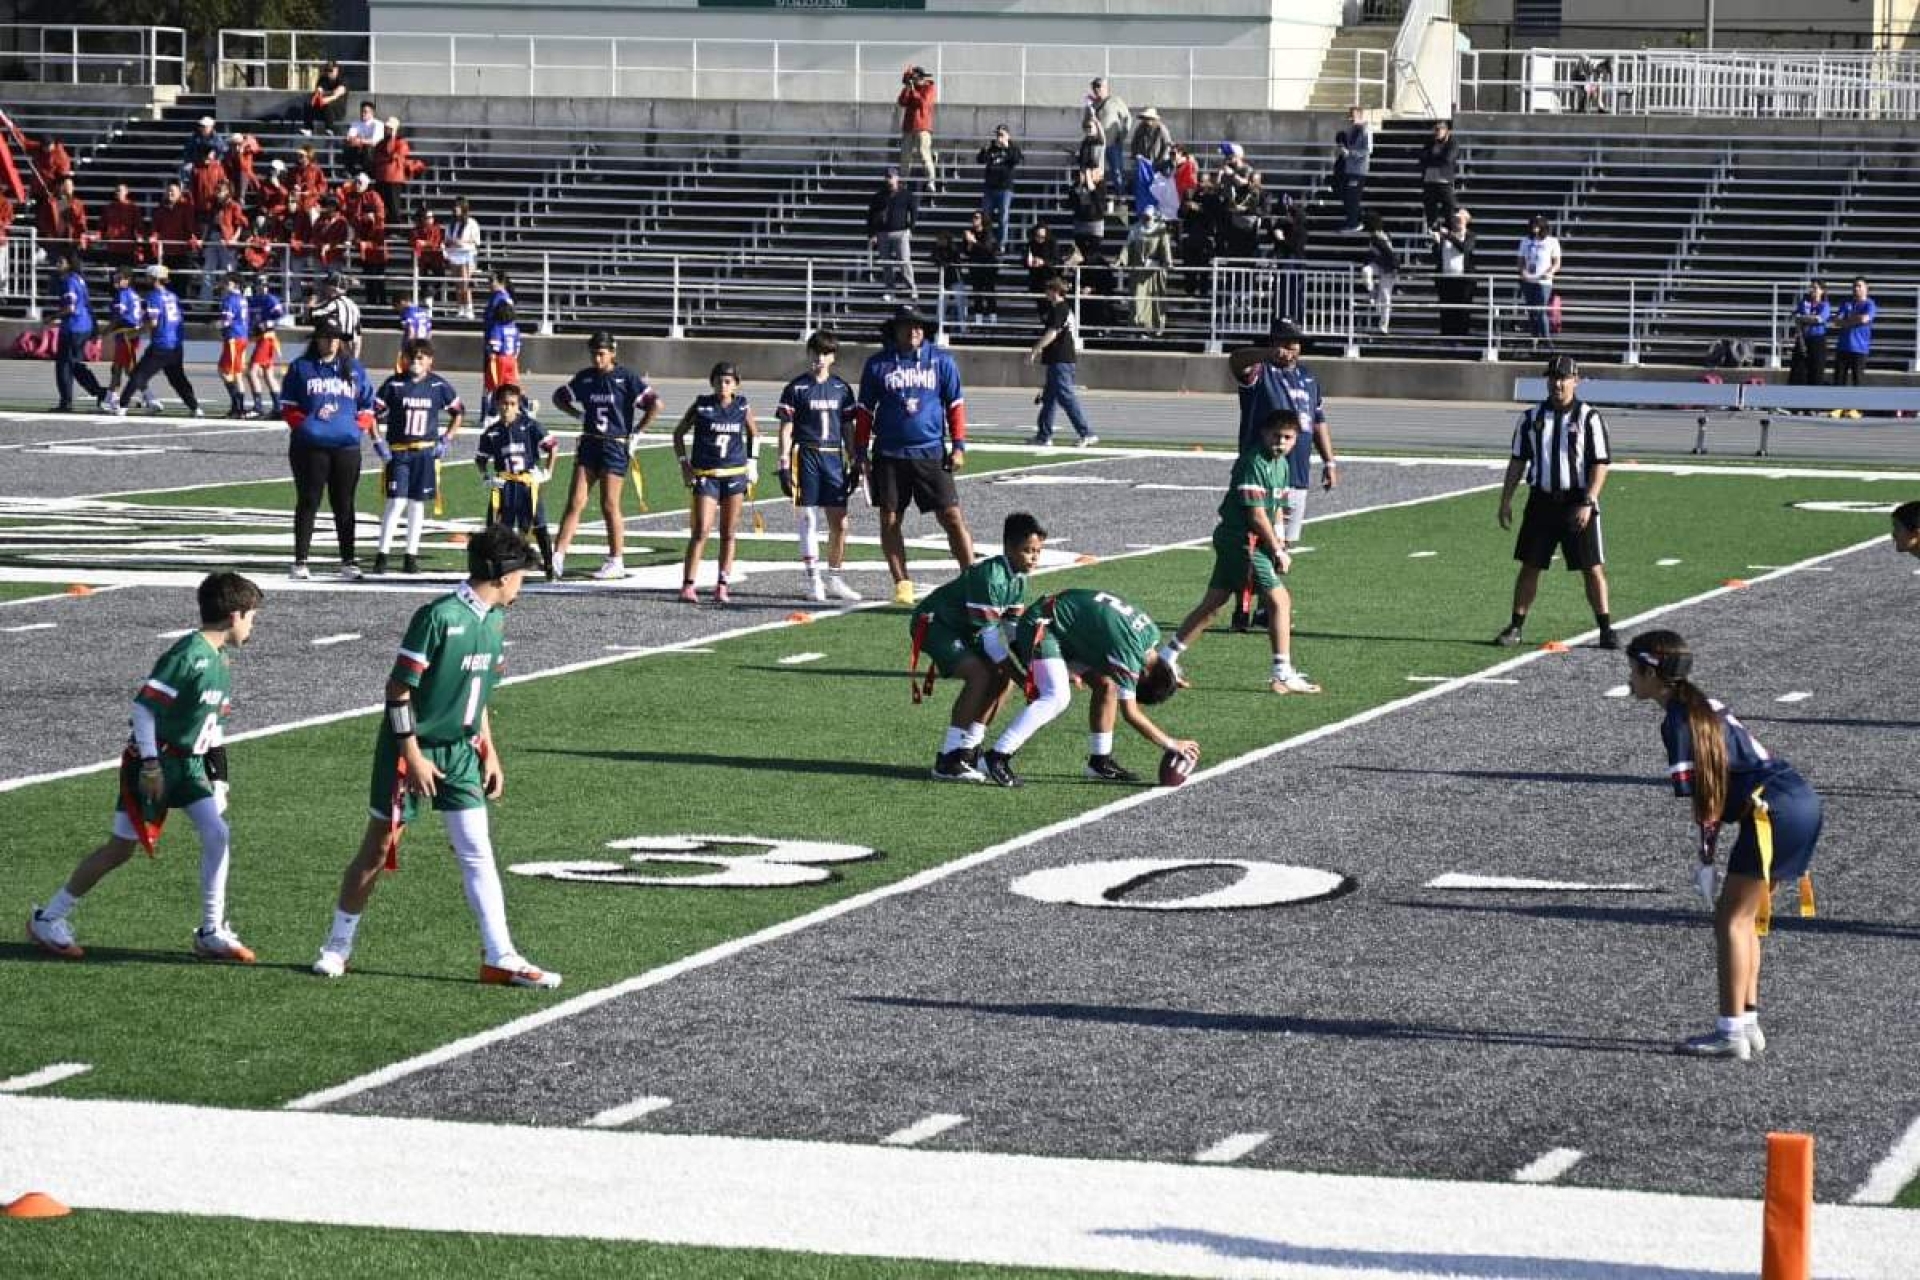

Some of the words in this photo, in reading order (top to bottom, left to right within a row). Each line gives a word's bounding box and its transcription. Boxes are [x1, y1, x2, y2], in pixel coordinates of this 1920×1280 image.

[404, 409, 428, 436] 10
[596, 407, 609, 433] 5
[820, 410, 830, 441] 1
[463, 676, 481, 726] 1
